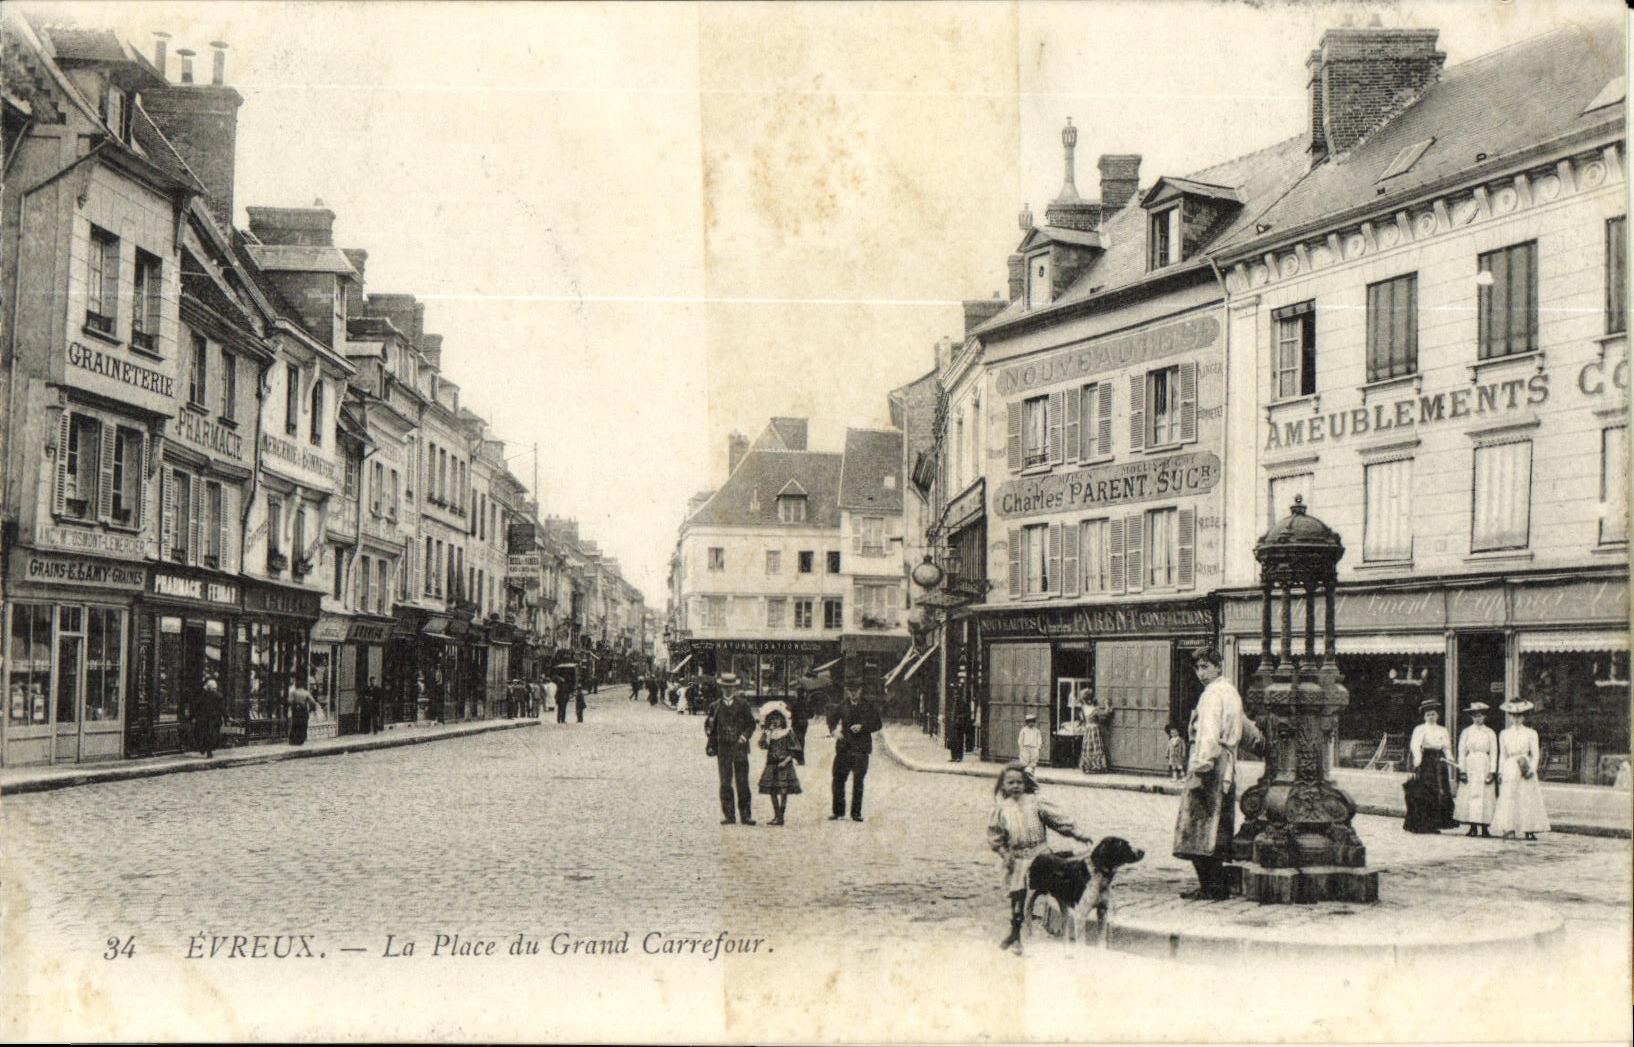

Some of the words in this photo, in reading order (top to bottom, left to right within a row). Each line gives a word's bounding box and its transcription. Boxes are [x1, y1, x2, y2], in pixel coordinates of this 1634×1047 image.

[68, 341, 174, 398] GRAINETERIE
[1264, 373, 1550, 451] AMEUBLEMENTS
[176, 405, 243, 460] PHARMACIE
[1002, 488, 1064, 514] Charles
[1073, 608, 1138, 632] PARENT
[1139, 609, 1213, 627] CONFECTIONS
[716, 641, 800, 650] NATURALISATION
